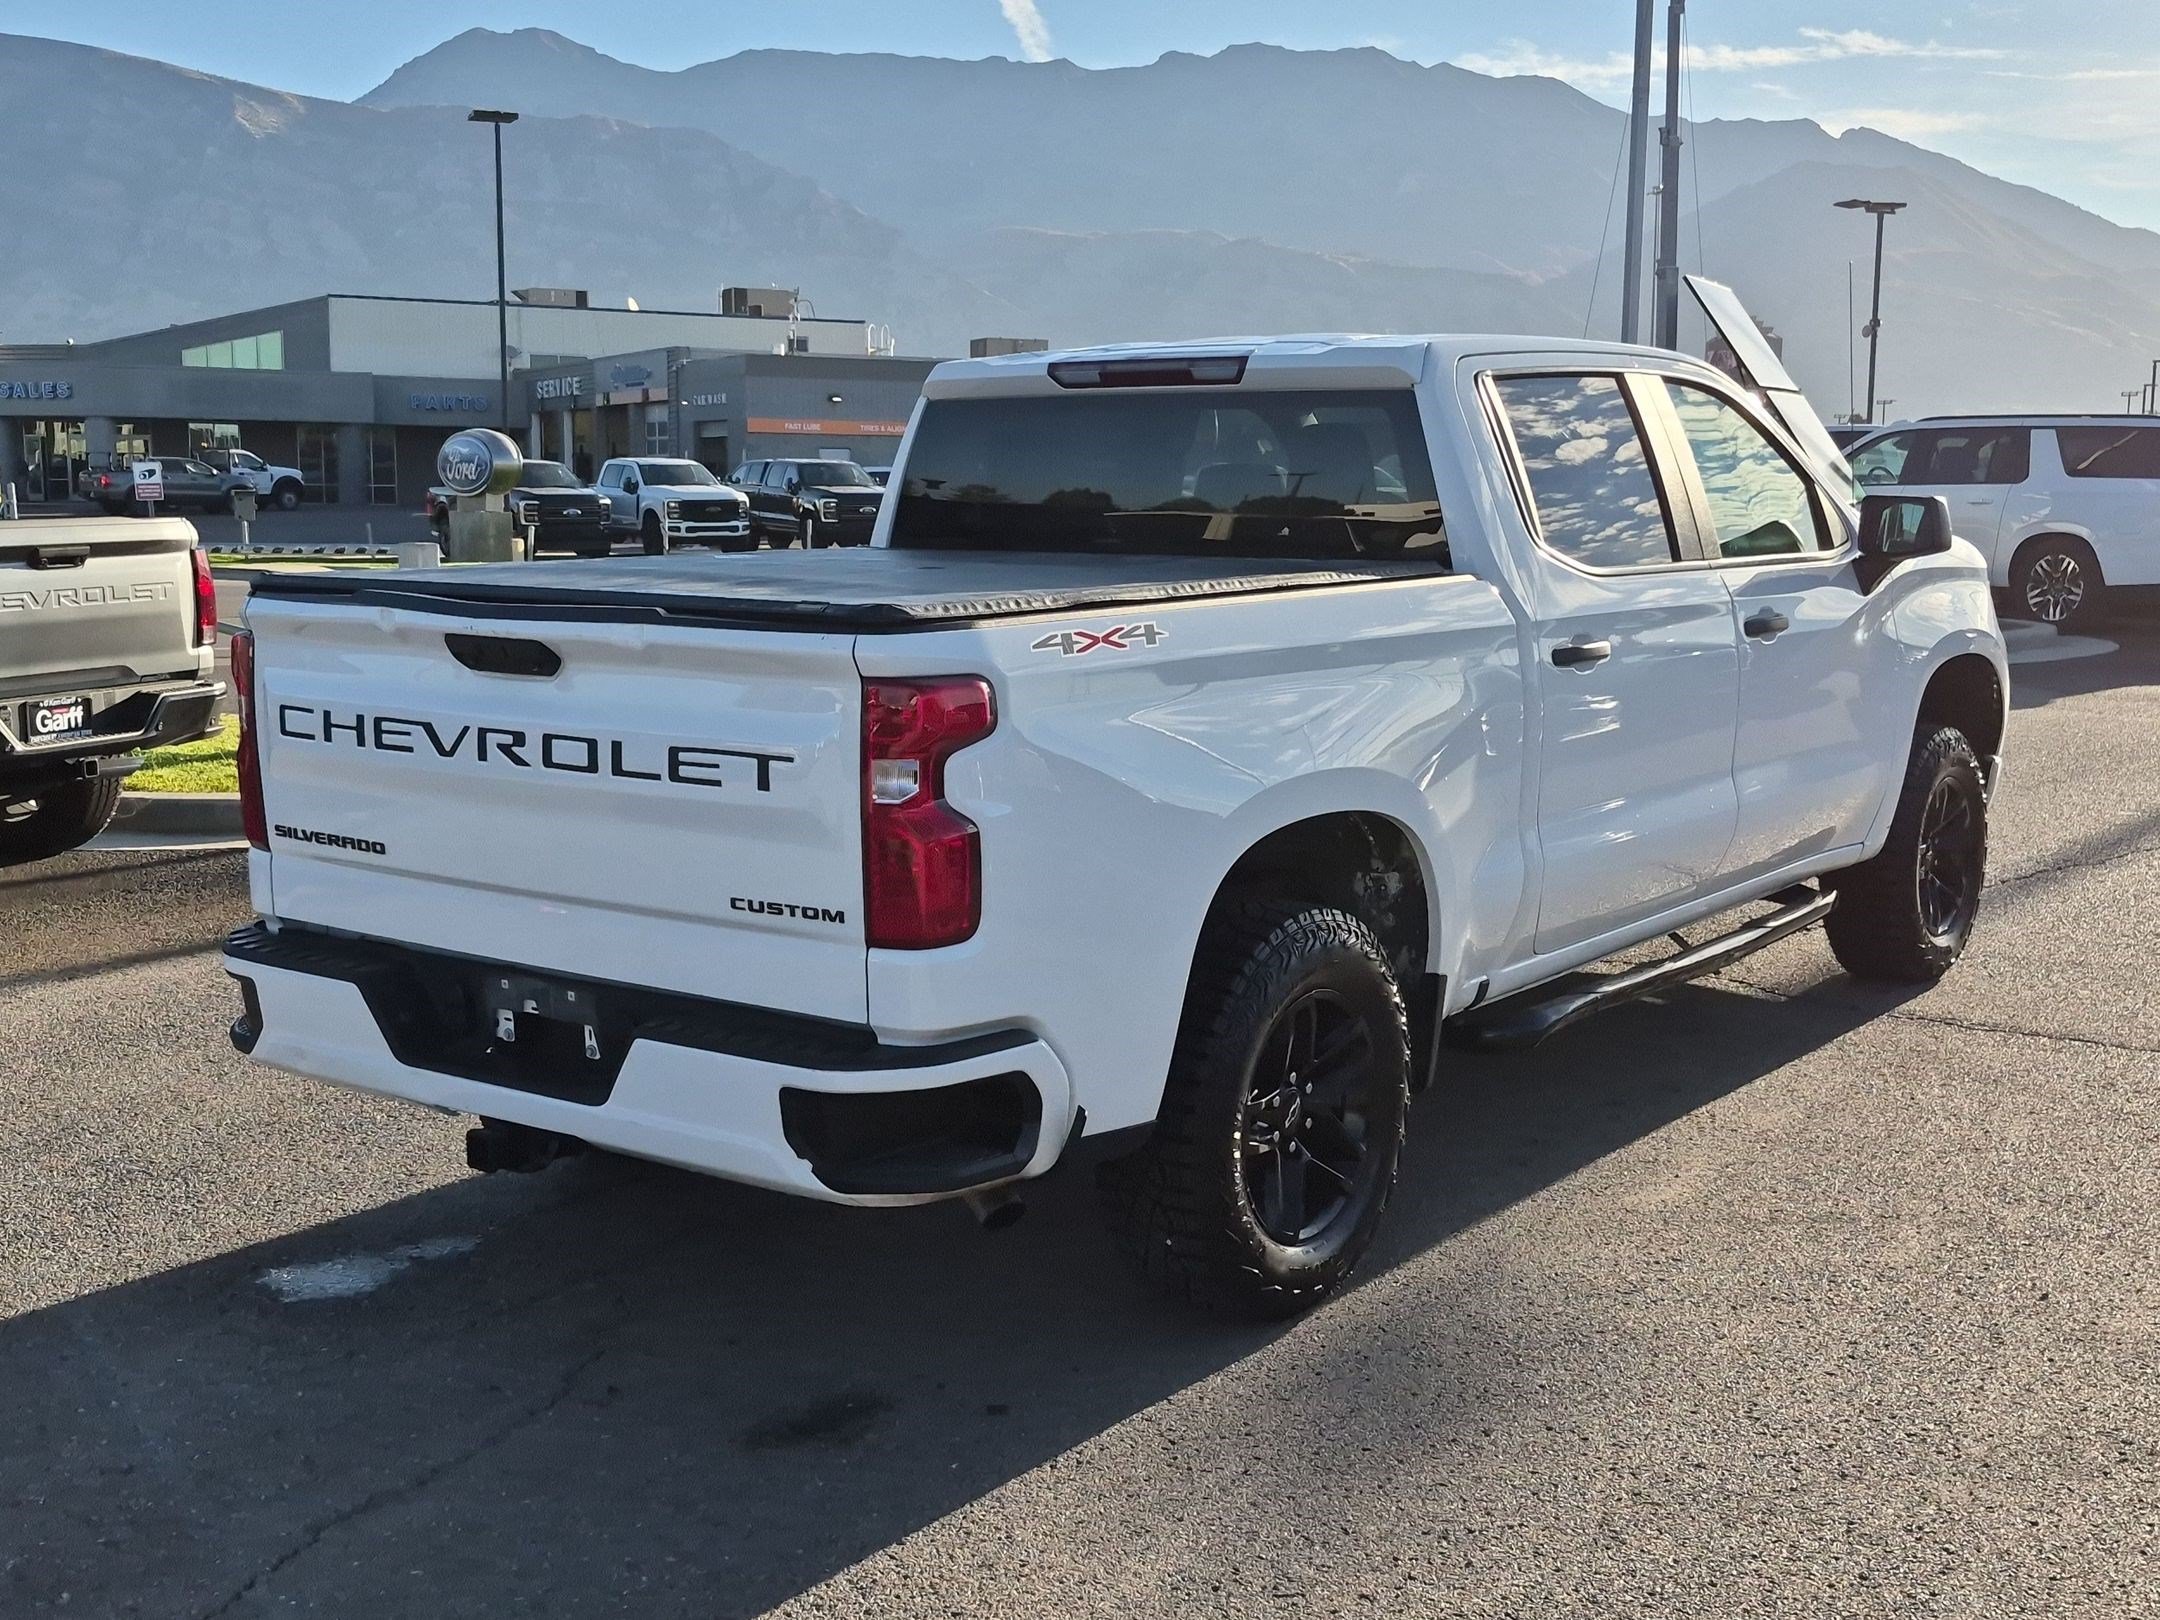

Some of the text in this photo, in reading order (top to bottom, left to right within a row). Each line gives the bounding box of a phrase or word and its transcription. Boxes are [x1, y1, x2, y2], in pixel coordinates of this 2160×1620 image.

[0, 381, 71, 399] SALES
[536, 376, 582, 400] SERVICE
[410, 394, 488, 412] PARTS
[784, 423, 802, 431] FAST
[445, 446, 484, 480] Ford
[36, 705, 84, 733] Garff
[279, 704, 796, 793] CHEVROLET
[273, 824, 387, 855] SILVERADO
[729, 896, 846, 925] CUSTOM
